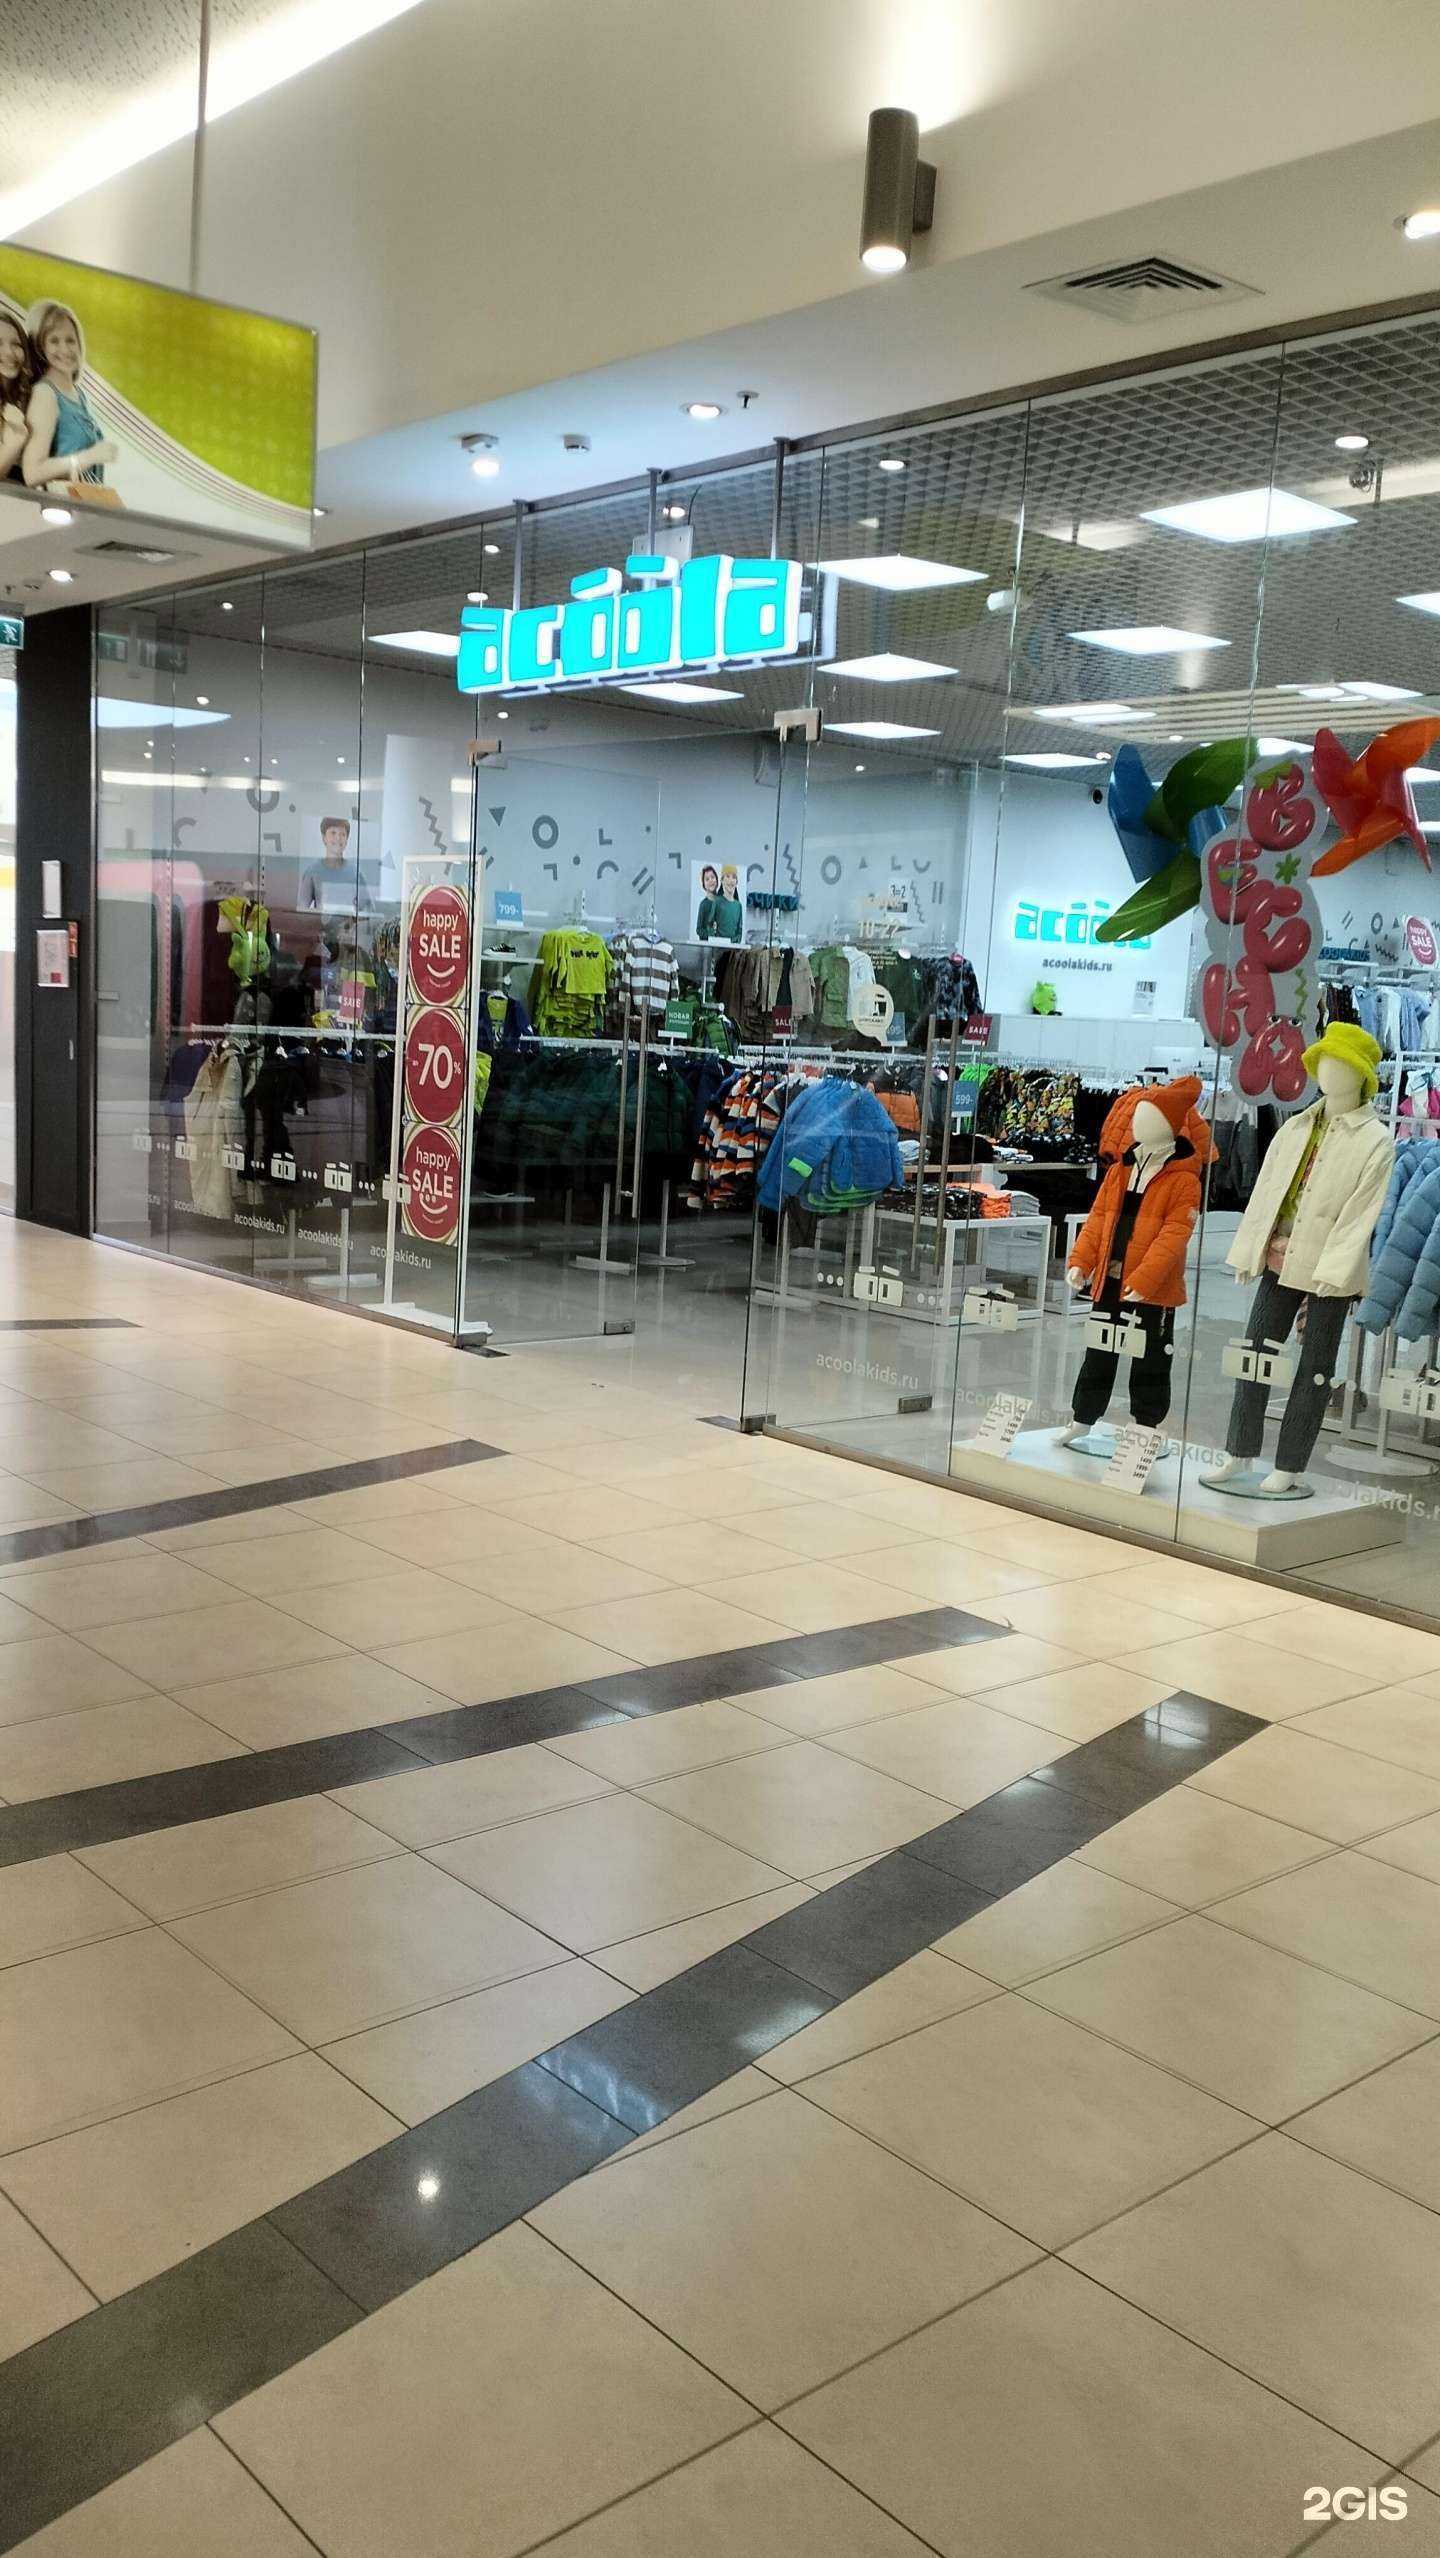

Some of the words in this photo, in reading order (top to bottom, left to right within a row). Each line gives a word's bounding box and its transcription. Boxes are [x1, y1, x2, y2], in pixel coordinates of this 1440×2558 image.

[419, 933, 462, 959] SALE
[1411, 935, 1432, 948] SALE
[1042, 958, 1113, 972] acoolakids.ru
[412, 1168, 454, 1199] SALE
[233, 1213, 286, 1235] acoolakids.ru
[370, 1244, 431, 1269] acoakids.ru
[816, 1354, 919, 1390] acoolakids.ru
